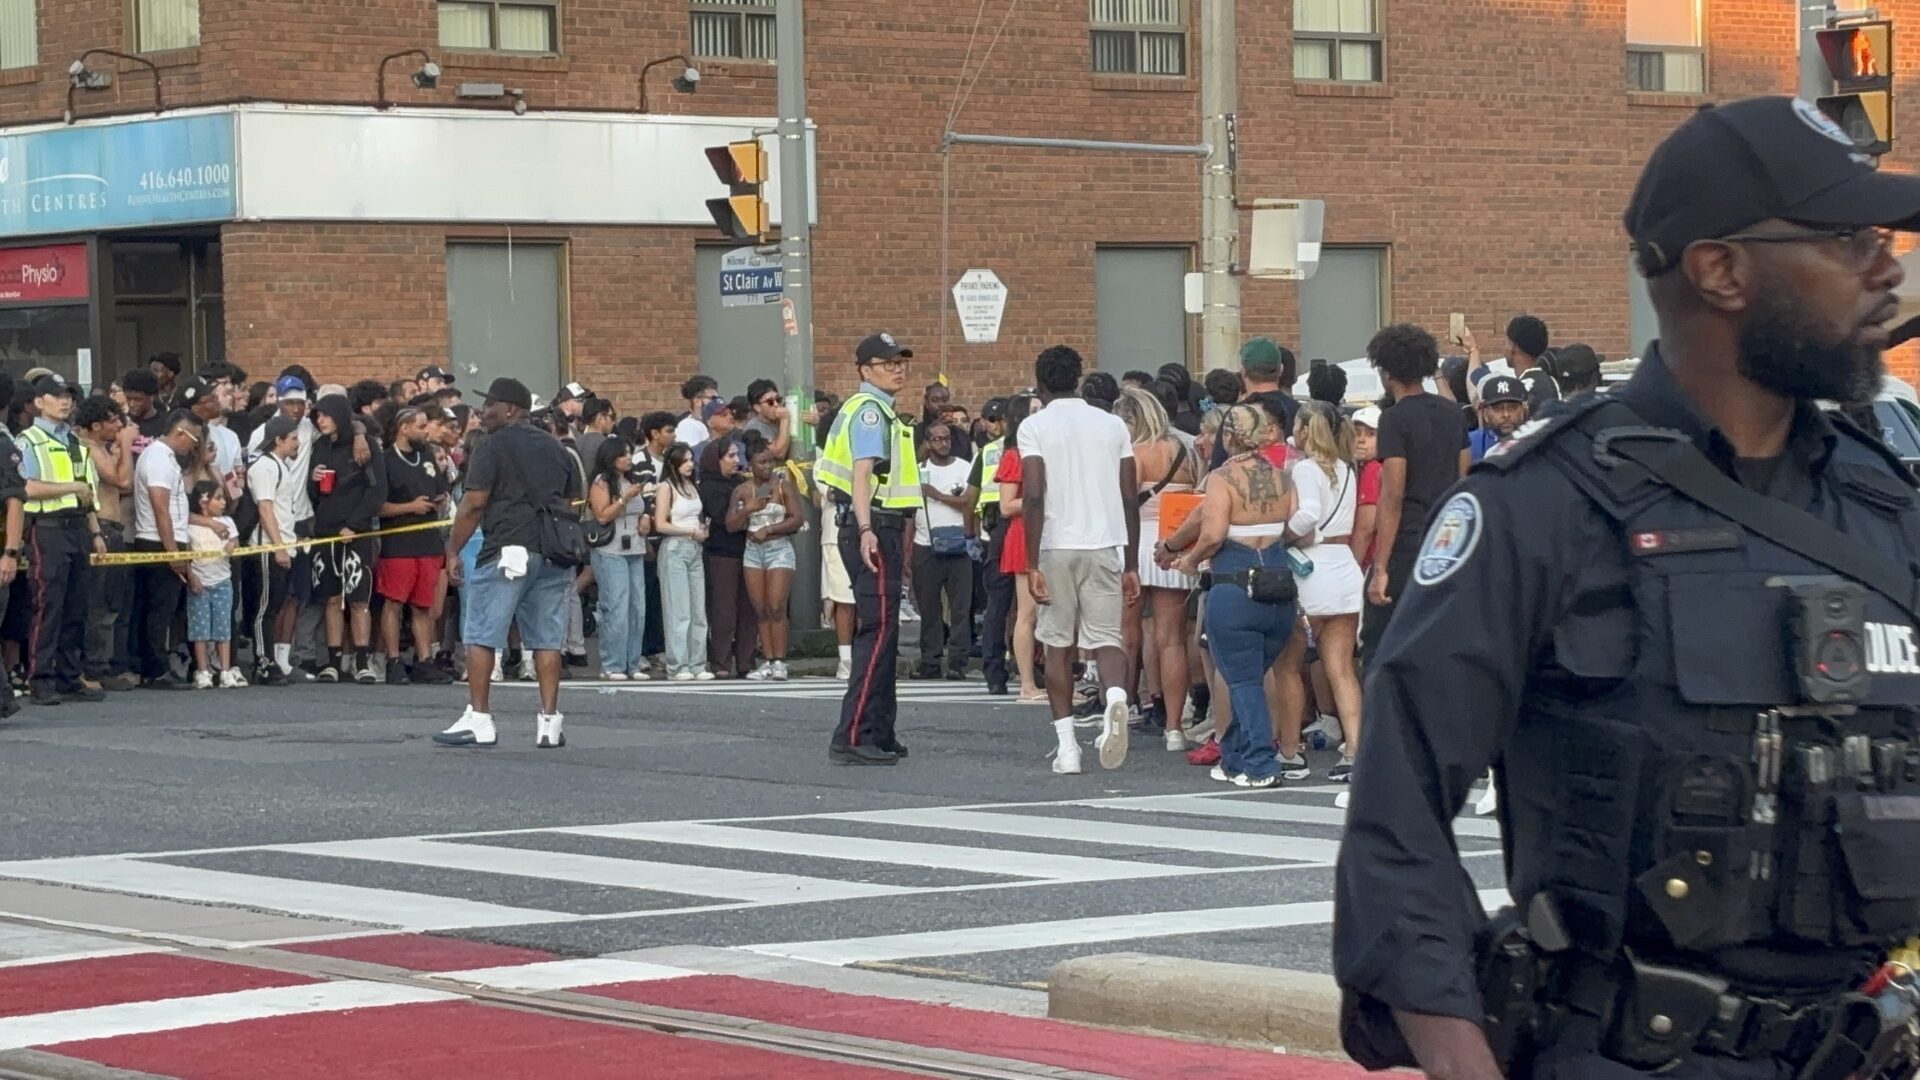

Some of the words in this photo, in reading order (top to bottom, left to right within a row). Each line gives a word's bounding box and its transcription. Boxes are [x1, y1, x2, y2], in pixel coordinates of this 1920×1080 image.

[139, 164, 230, 190] 416.640.1000
[31, 191, 107, 213] CENTRES
[22, 263, 57, 288] Physio
[723, 274, 734, 291] St
[735, 272, 760, 290] Clair
[762, 275, 773, 289] Av
[1496, 380, 1510, 394] NY
[1864, 621, 1920, 674] OLICE
